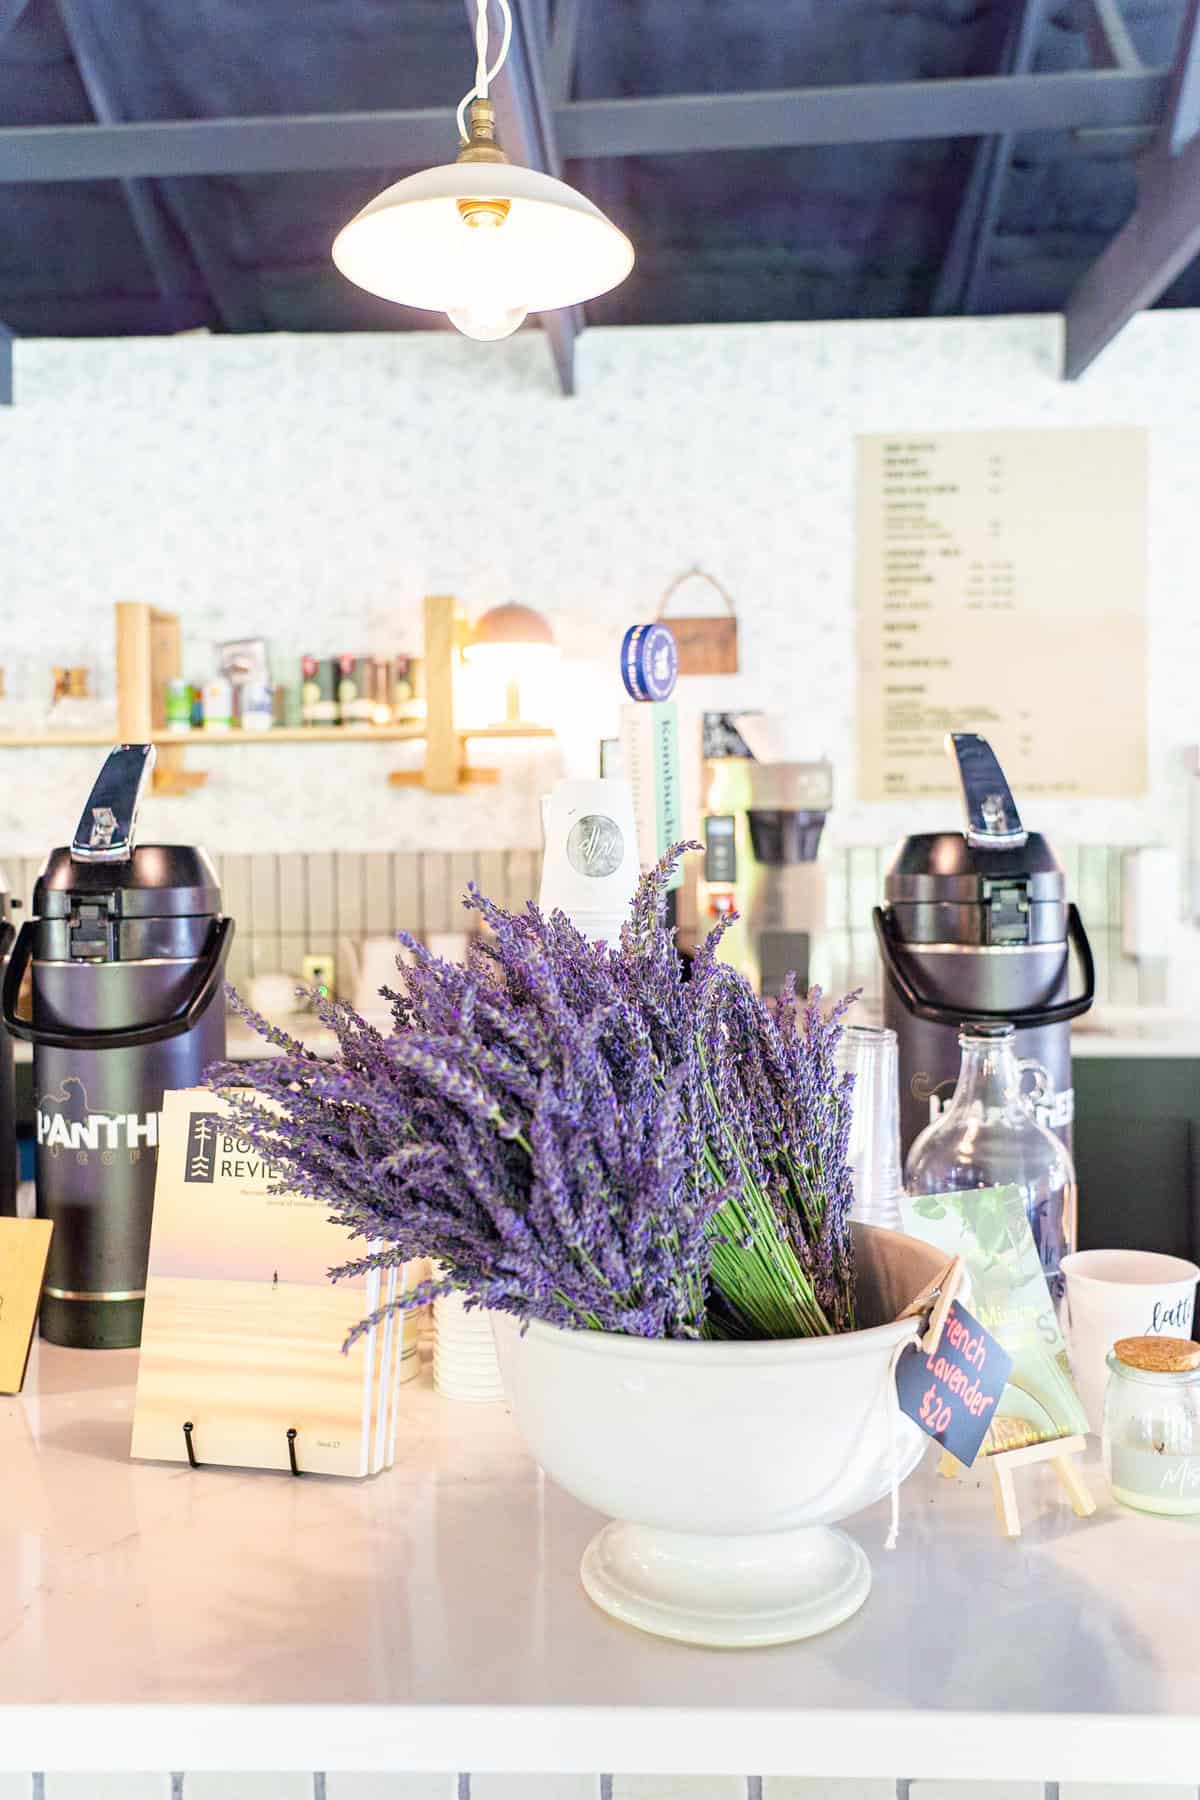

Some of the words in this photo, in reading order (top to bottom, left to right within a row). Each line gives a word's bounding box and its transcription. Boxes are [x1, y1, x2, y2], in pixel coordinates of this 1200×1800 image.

[37, 1110, 158, 1149] PANTH
[222, 1135, 258, 1154] BO
[926, 1352, 994, 1416] Lavender
[919, 1383, 952, 1433] $20
